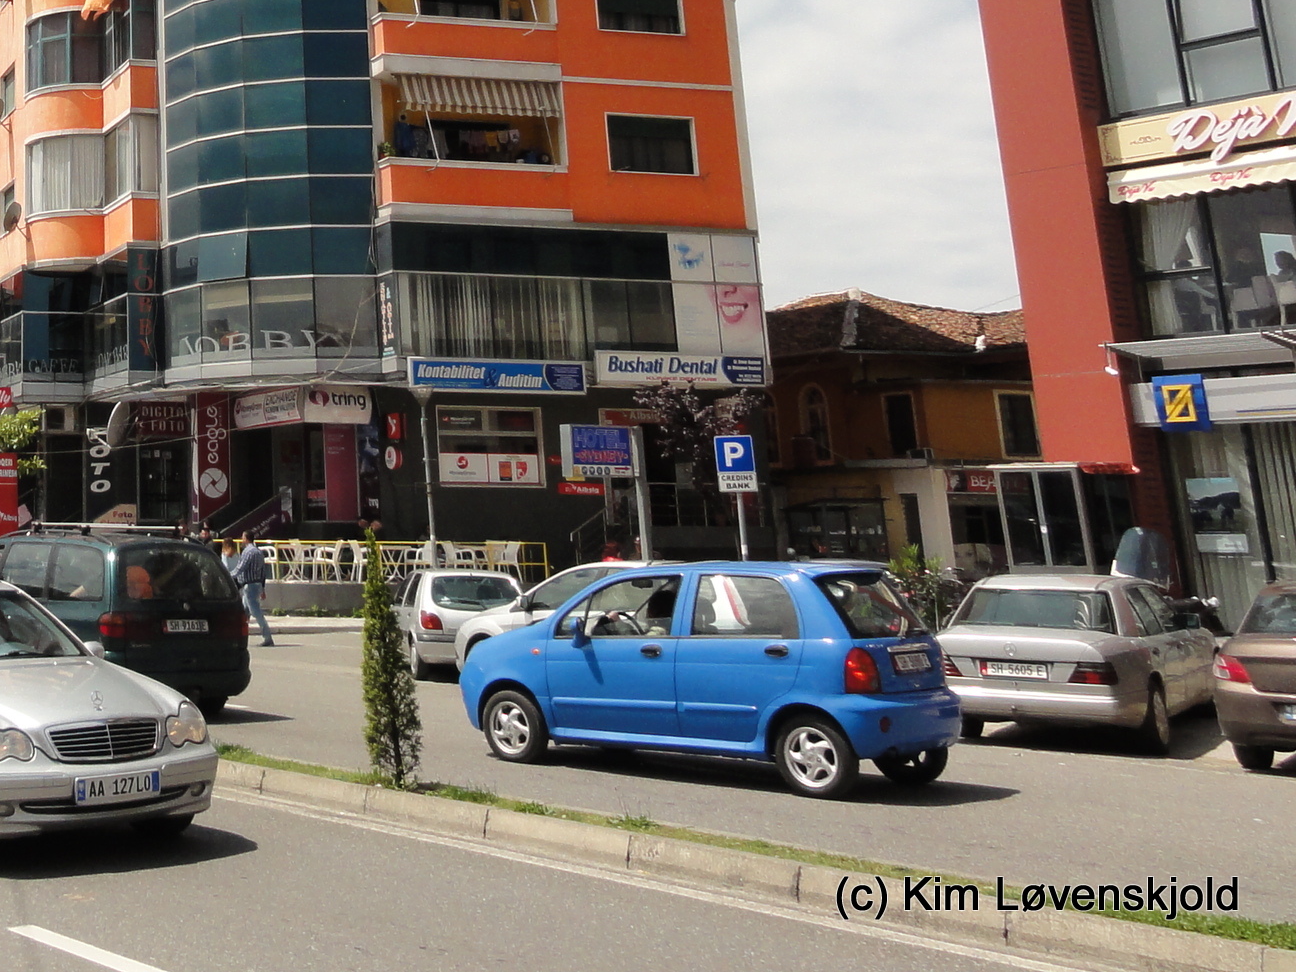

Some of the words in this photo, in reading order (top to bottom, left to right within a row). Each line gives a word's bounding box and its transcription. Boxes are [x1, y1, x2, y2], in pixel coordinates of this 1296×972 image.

[133, 253, 154, 356] LOBBY
[608, 355, 664, 374] Bushati
[668, 356, 718, 375] Dental
[417, 364, 486, 379] Kontabilitet
[498, 374, 544, 388] Auditim
[332, 392, 366, 410] tring
[574, 429, 626, 449] HOTEL
[723, 442, 744, 467] P
[112, 510, 133, 518] Foto
[991, 664, 1003, 674] SH
[1008, 665, 1033, 676] 5605
[1036, 666, 1044, 676] E
[89, 780, 105, 797] AA
